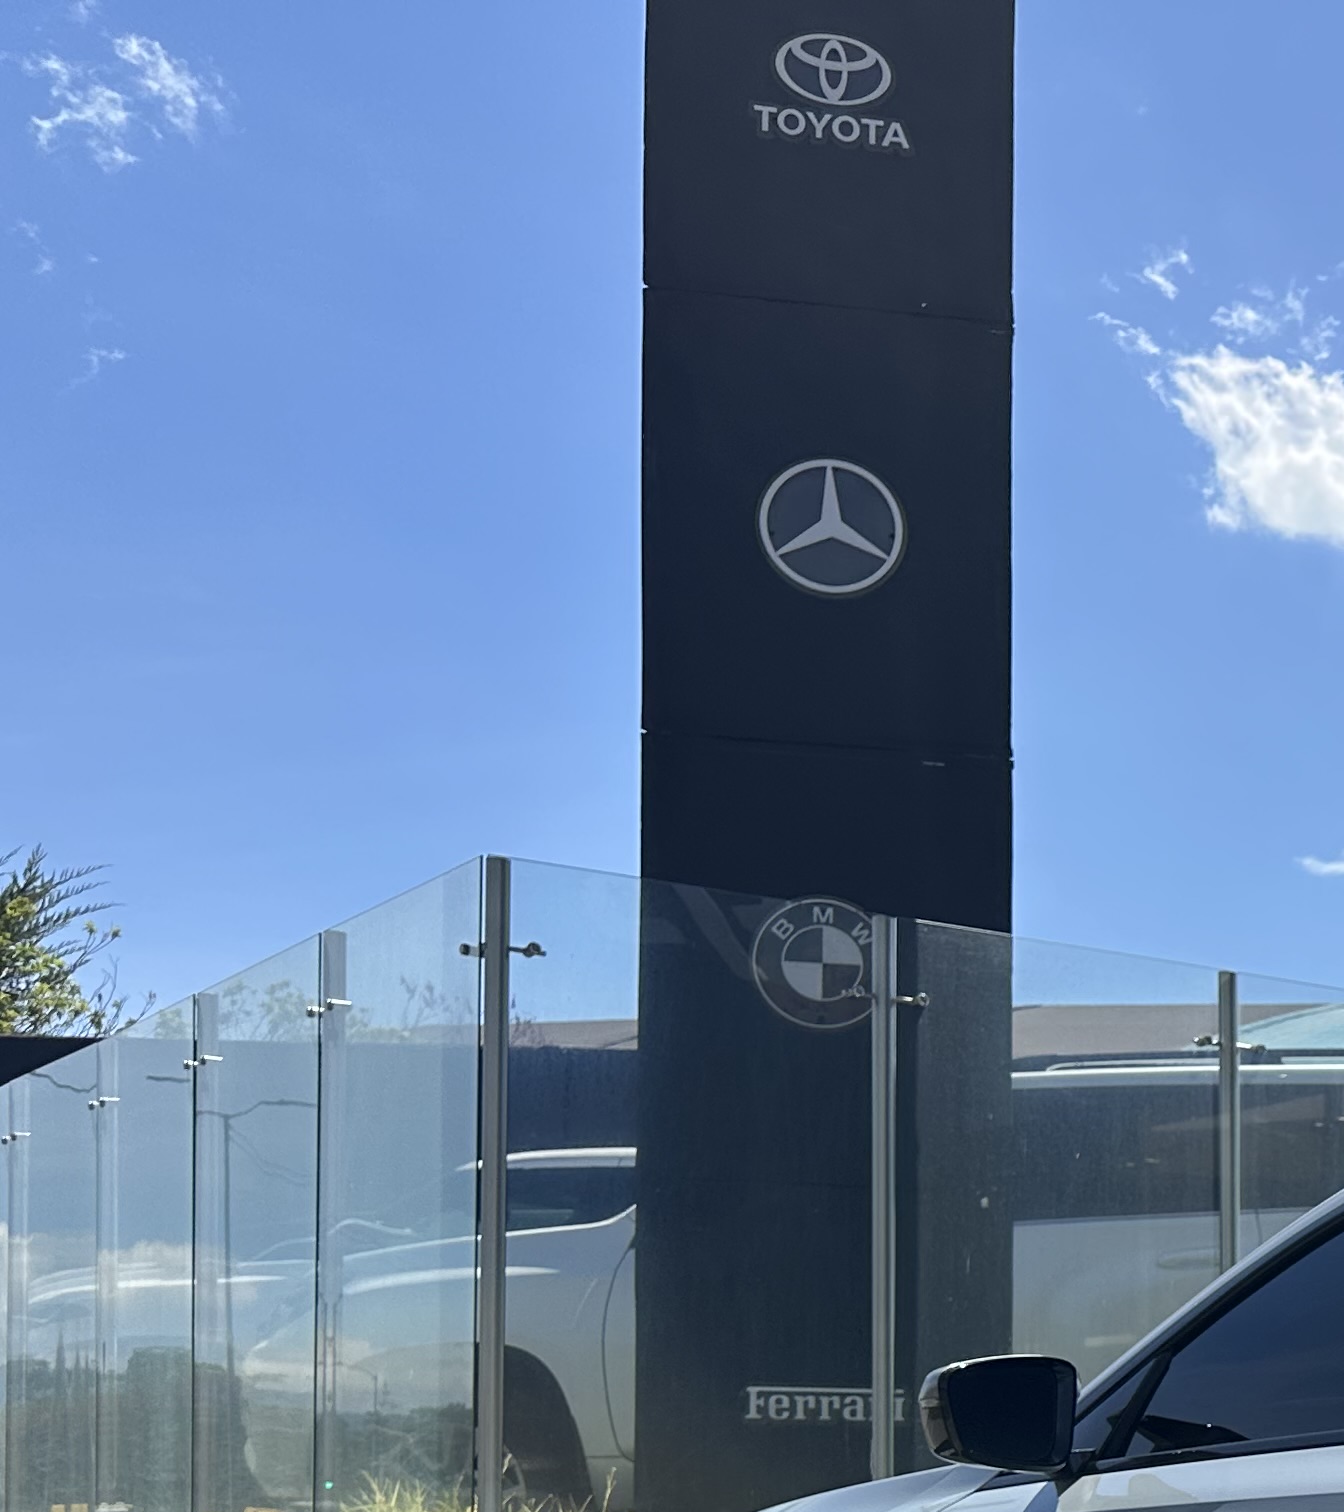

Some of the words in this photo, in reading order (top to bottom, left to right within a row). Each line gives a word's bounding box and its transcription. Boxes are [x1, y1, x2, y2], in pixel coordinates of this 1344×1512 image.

[753, 104, 909, 149] TOYOTA
[770, 905, 873, 947] BMW
[745, 1386, 905, 1422] Ferrai
